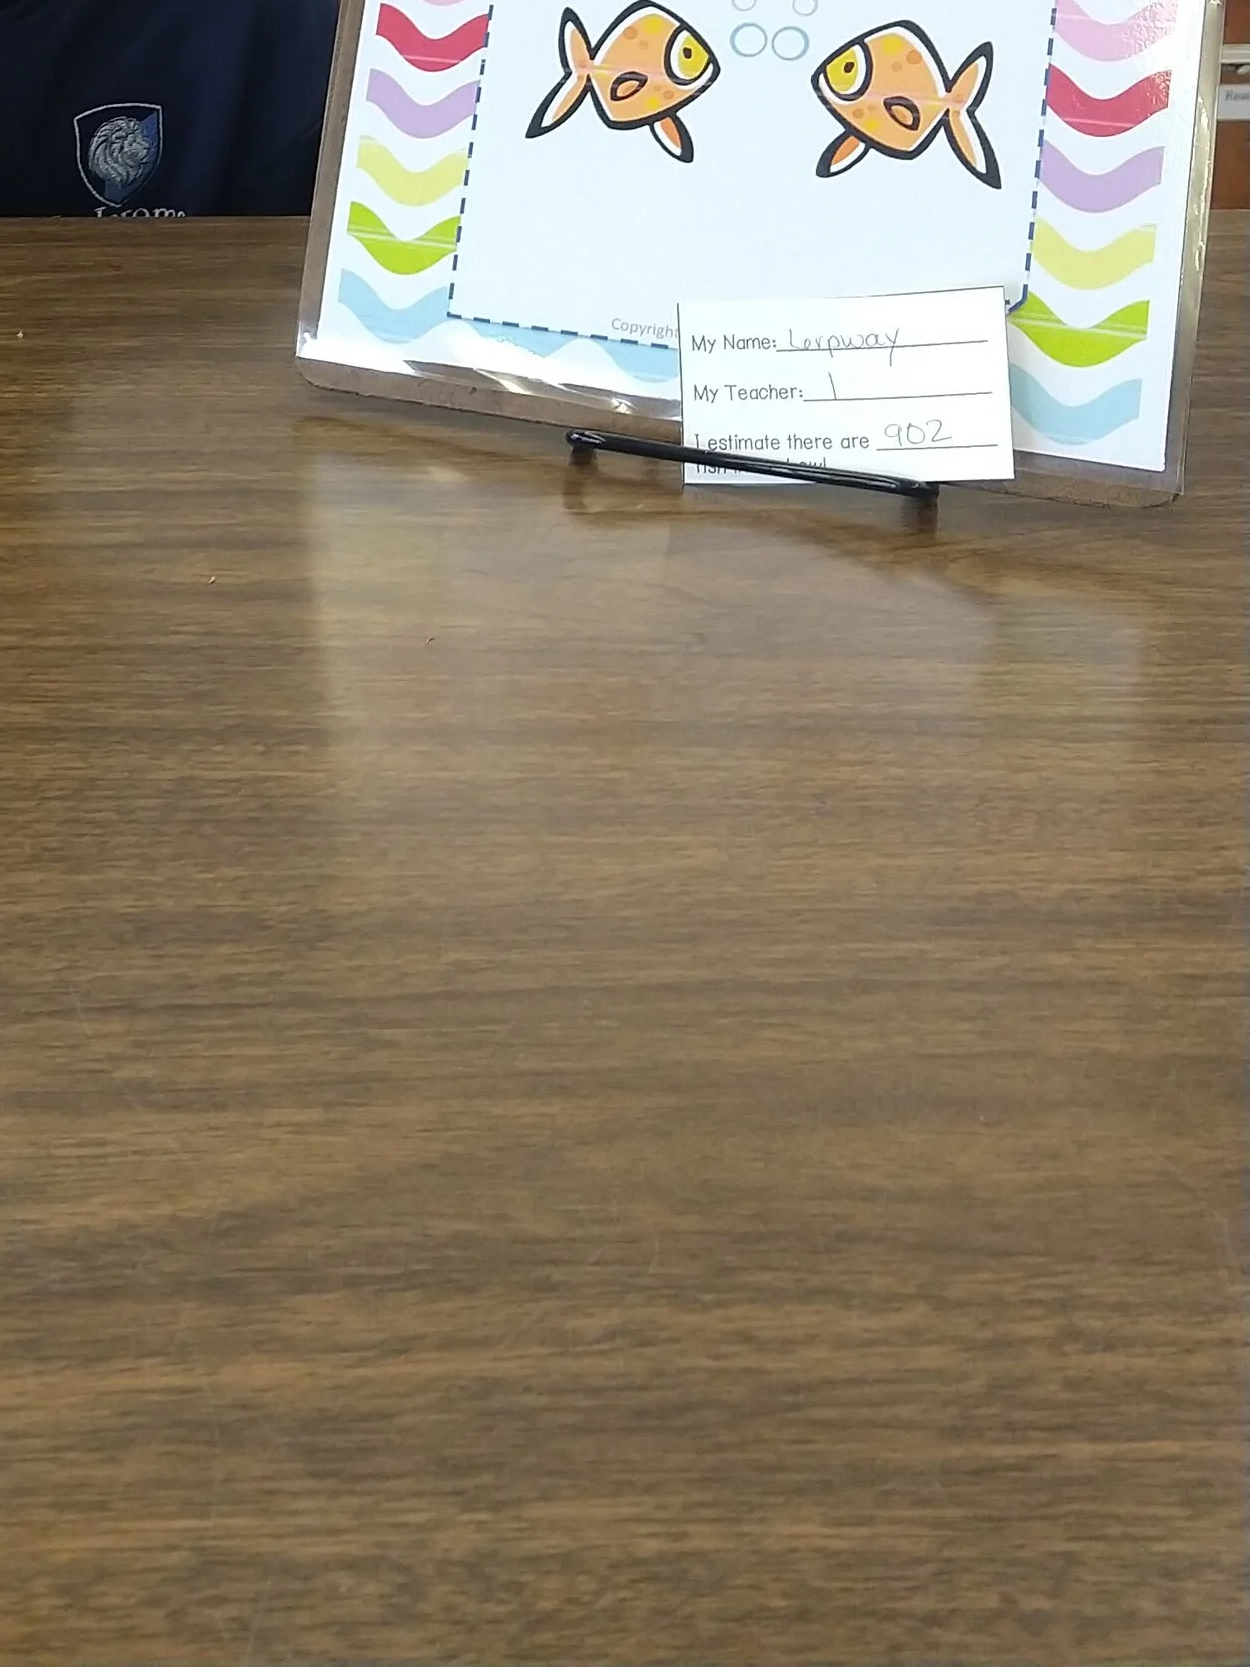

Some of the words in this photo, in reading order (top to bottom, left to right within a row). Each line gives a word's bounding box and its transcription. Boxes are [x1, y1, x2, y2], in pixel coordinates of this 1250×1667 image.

[692, 335, 716, 354] My
[723, 334, 777, 351] Name:
[694, 384, 718, 404] My
[724, 383, 803, 401] Teacher:
[707, 434, 781, 451] estimate
[786, 433, 833, 450] there
[840, 436, 870, 450] are
[884, 419, 952, 448] 902
